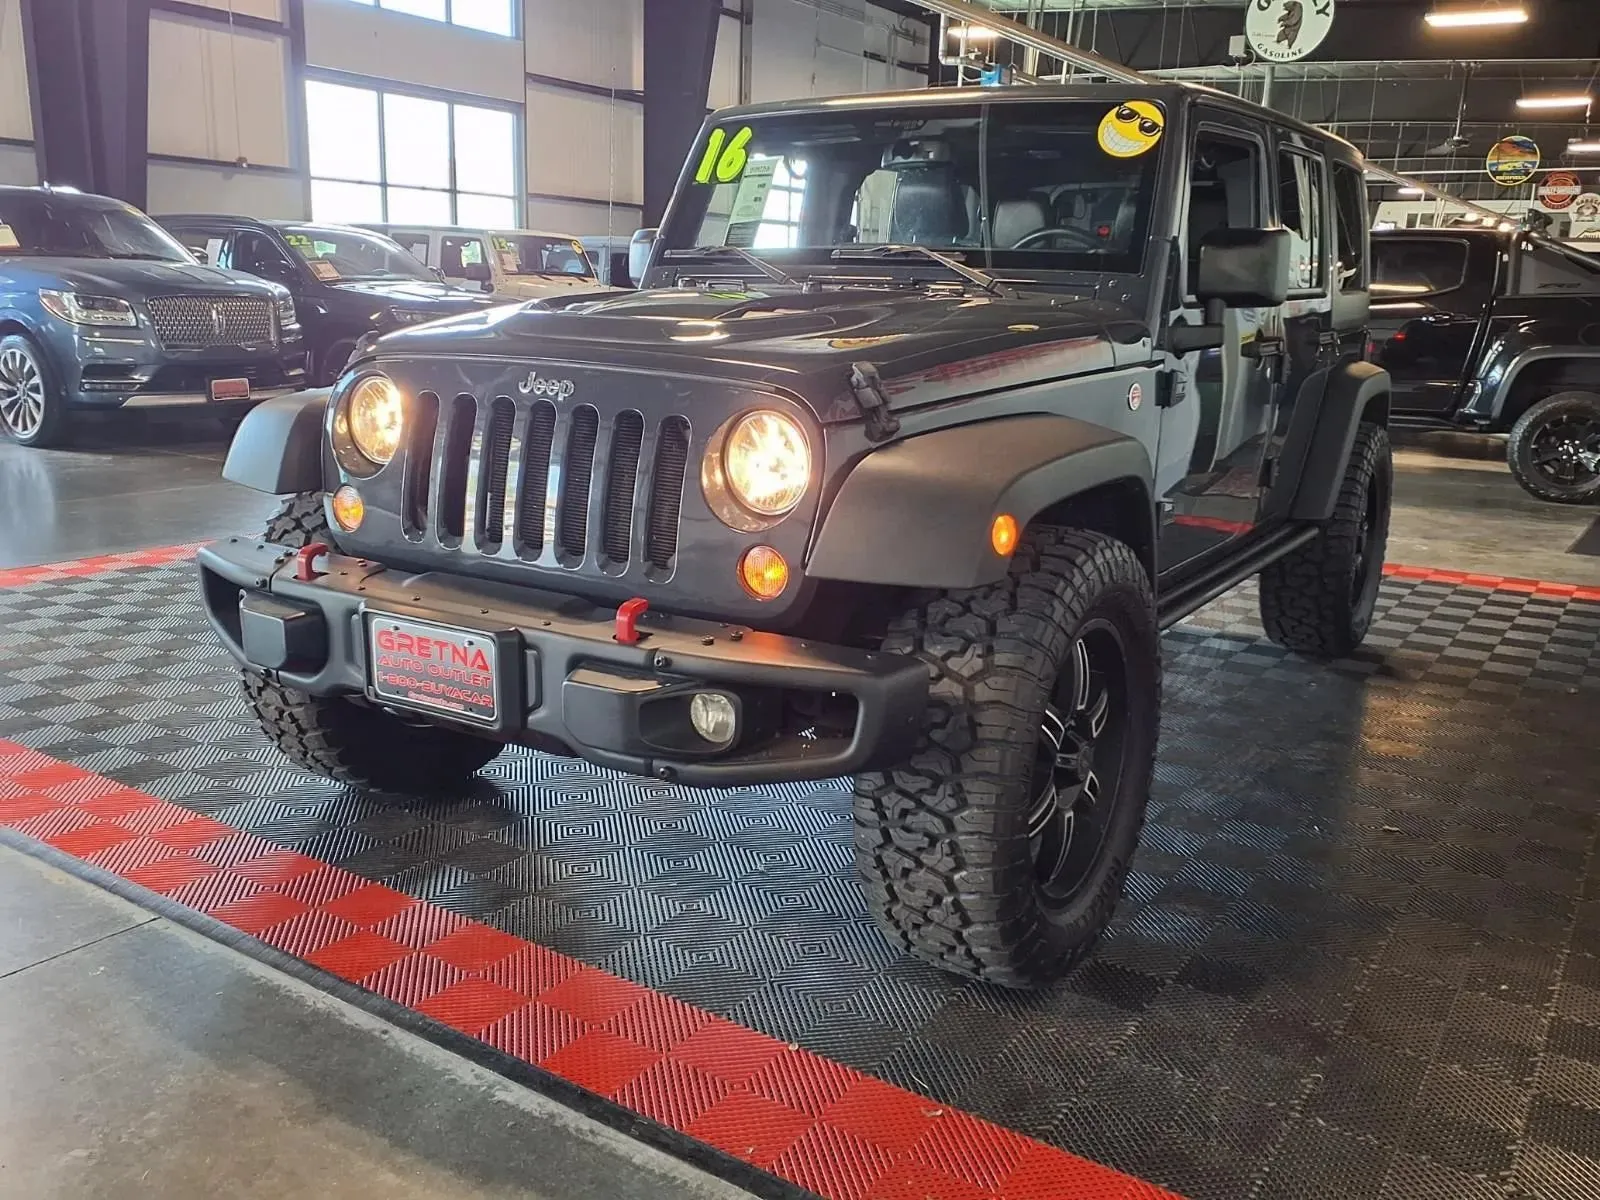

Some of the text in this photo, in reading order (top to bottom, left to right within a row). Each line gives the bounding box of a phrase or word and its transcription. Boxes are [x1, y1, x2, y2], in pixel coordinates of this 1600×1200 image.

[1257, 43, 1303, 58] GASOLINE
[695, 126, 753, 184] 16
[284, 234, 312, 247] 22
[518, 371, 575, 401] Jeep
[376, 629, 490, 672] GRETNA
[377, 655, 492, 689] AUTO OUTLET
[377, 670, 494, 708] 1-800-BUYACAR
